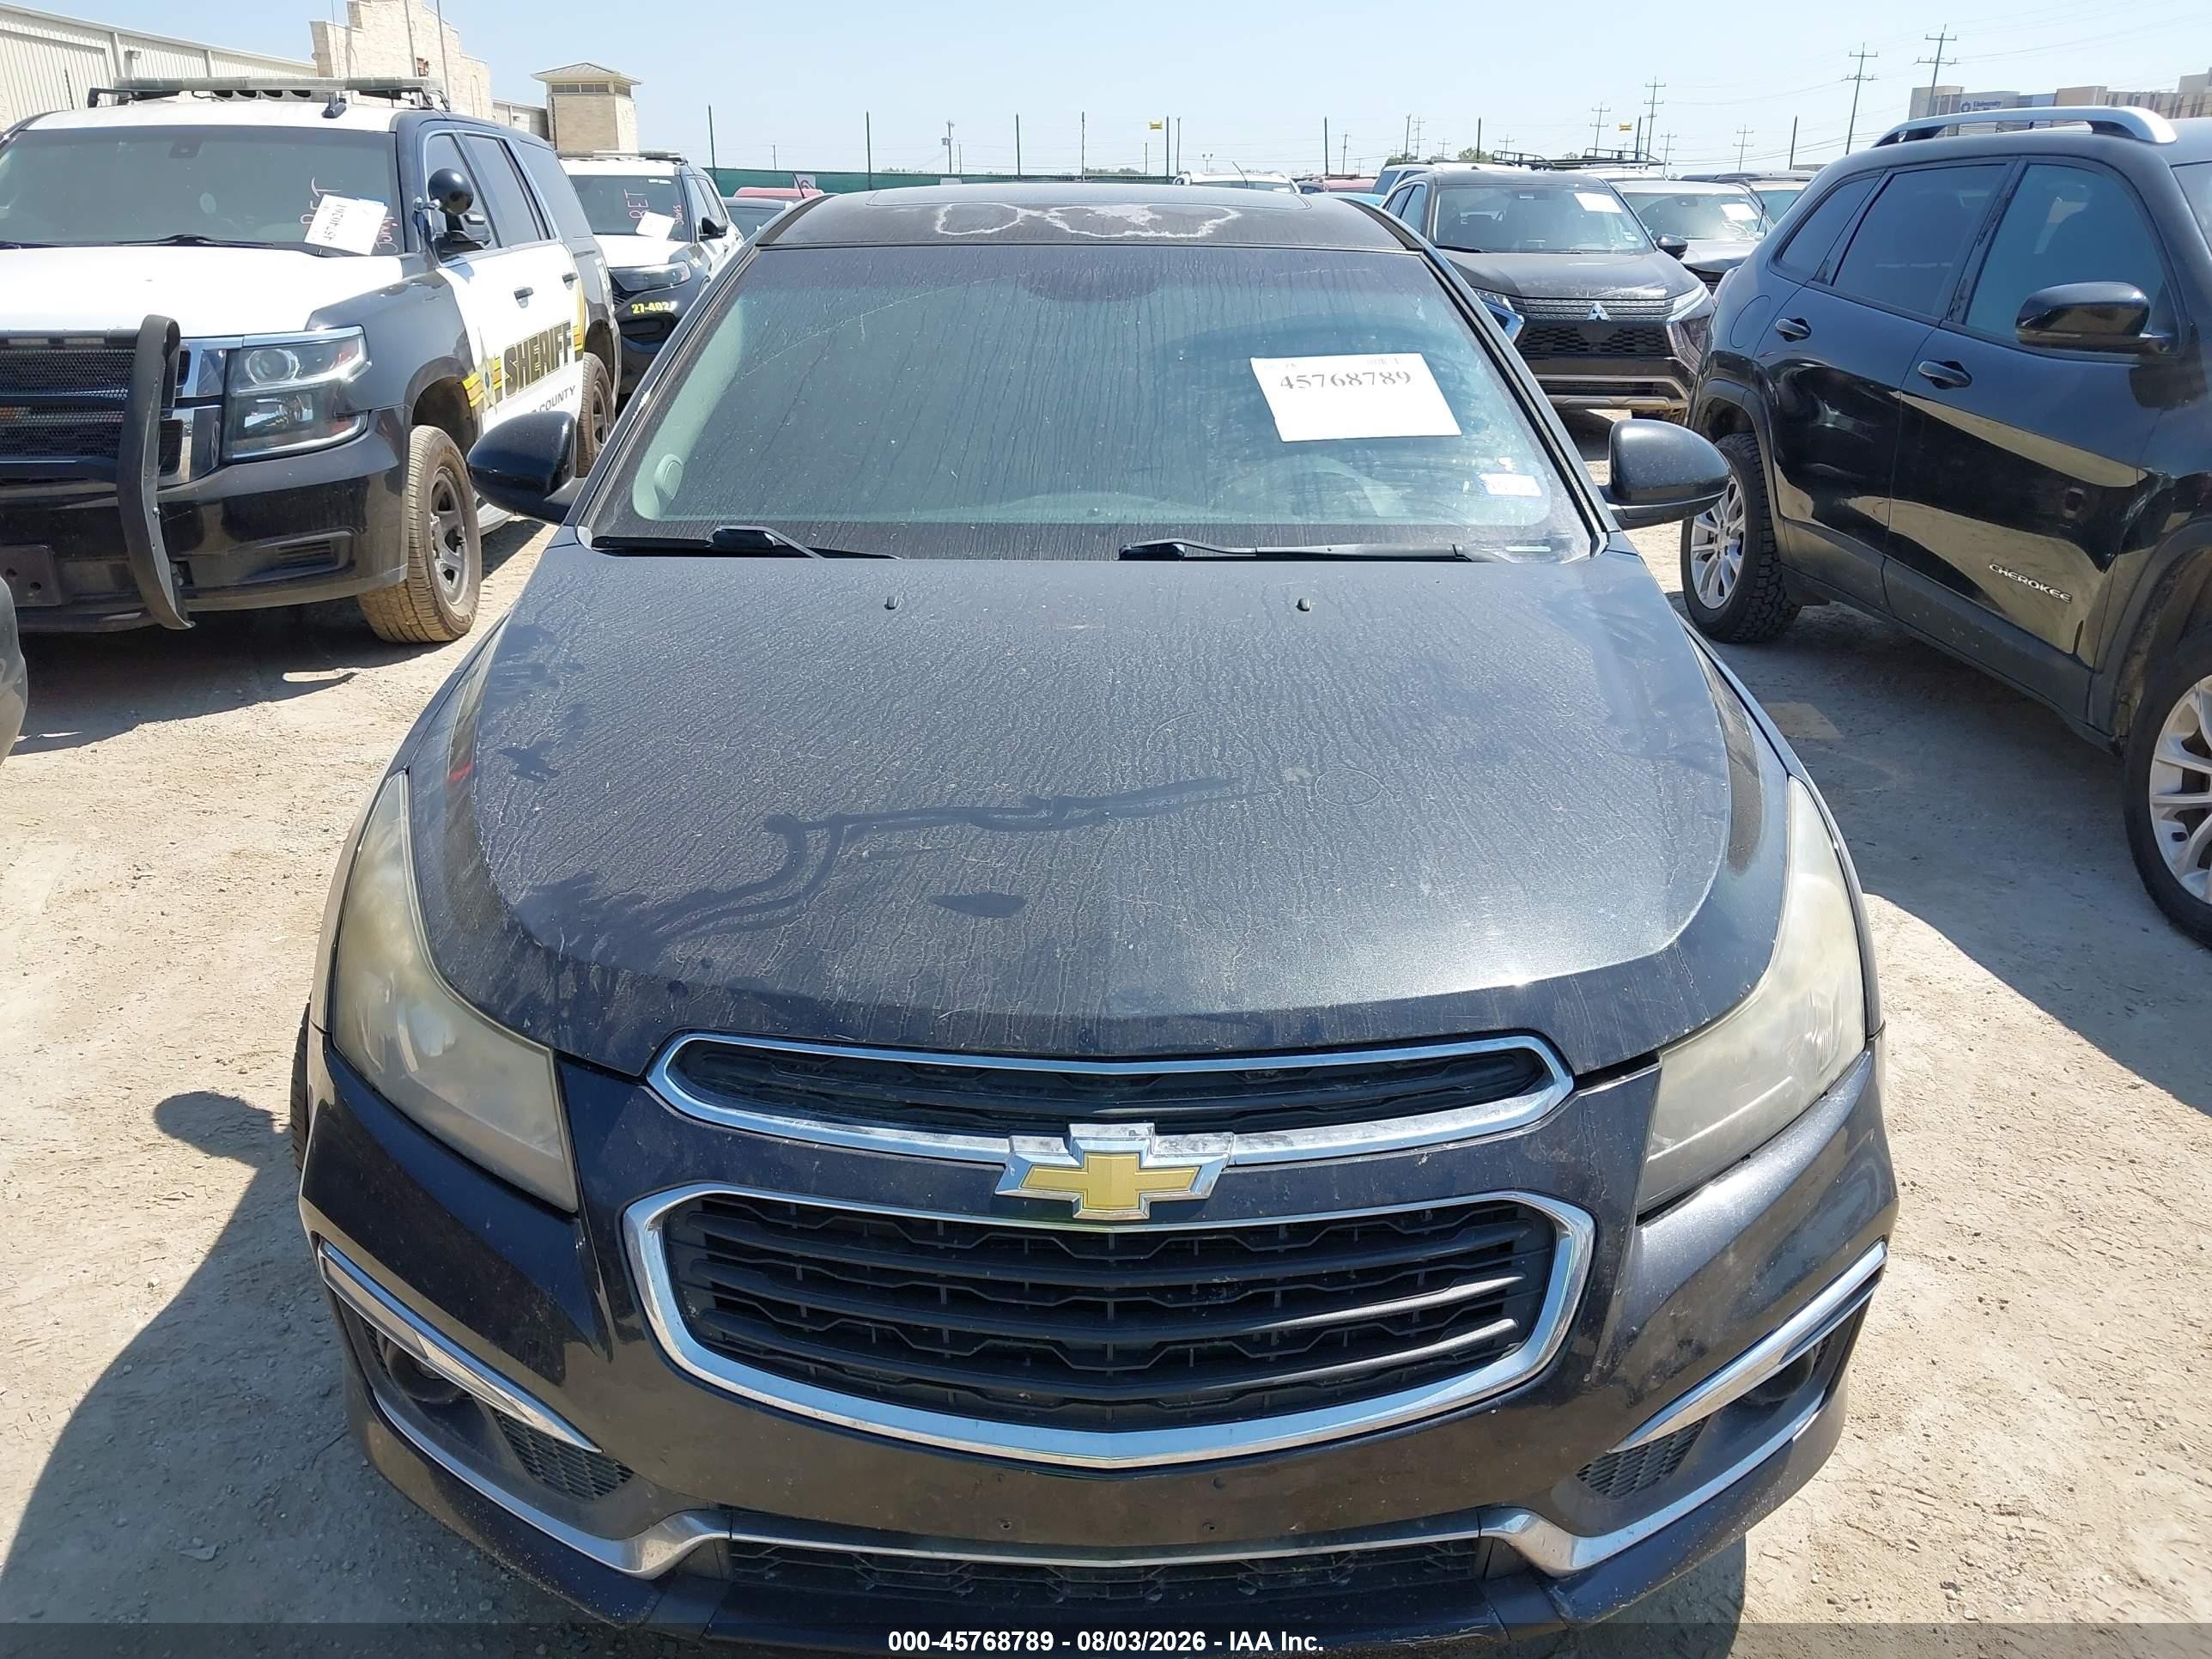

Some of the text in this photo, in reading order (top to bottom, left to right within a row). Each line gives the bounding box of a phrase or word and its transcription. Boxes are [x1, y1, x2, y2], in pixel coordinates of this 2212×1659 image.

[504, 318, 573, 398] SHERIFF
[1280, 370, 1412, 389] 45768789
[539, 385, 575, 411] COUNTY
[1989, 563, 2073, 603] CHEROKEE
